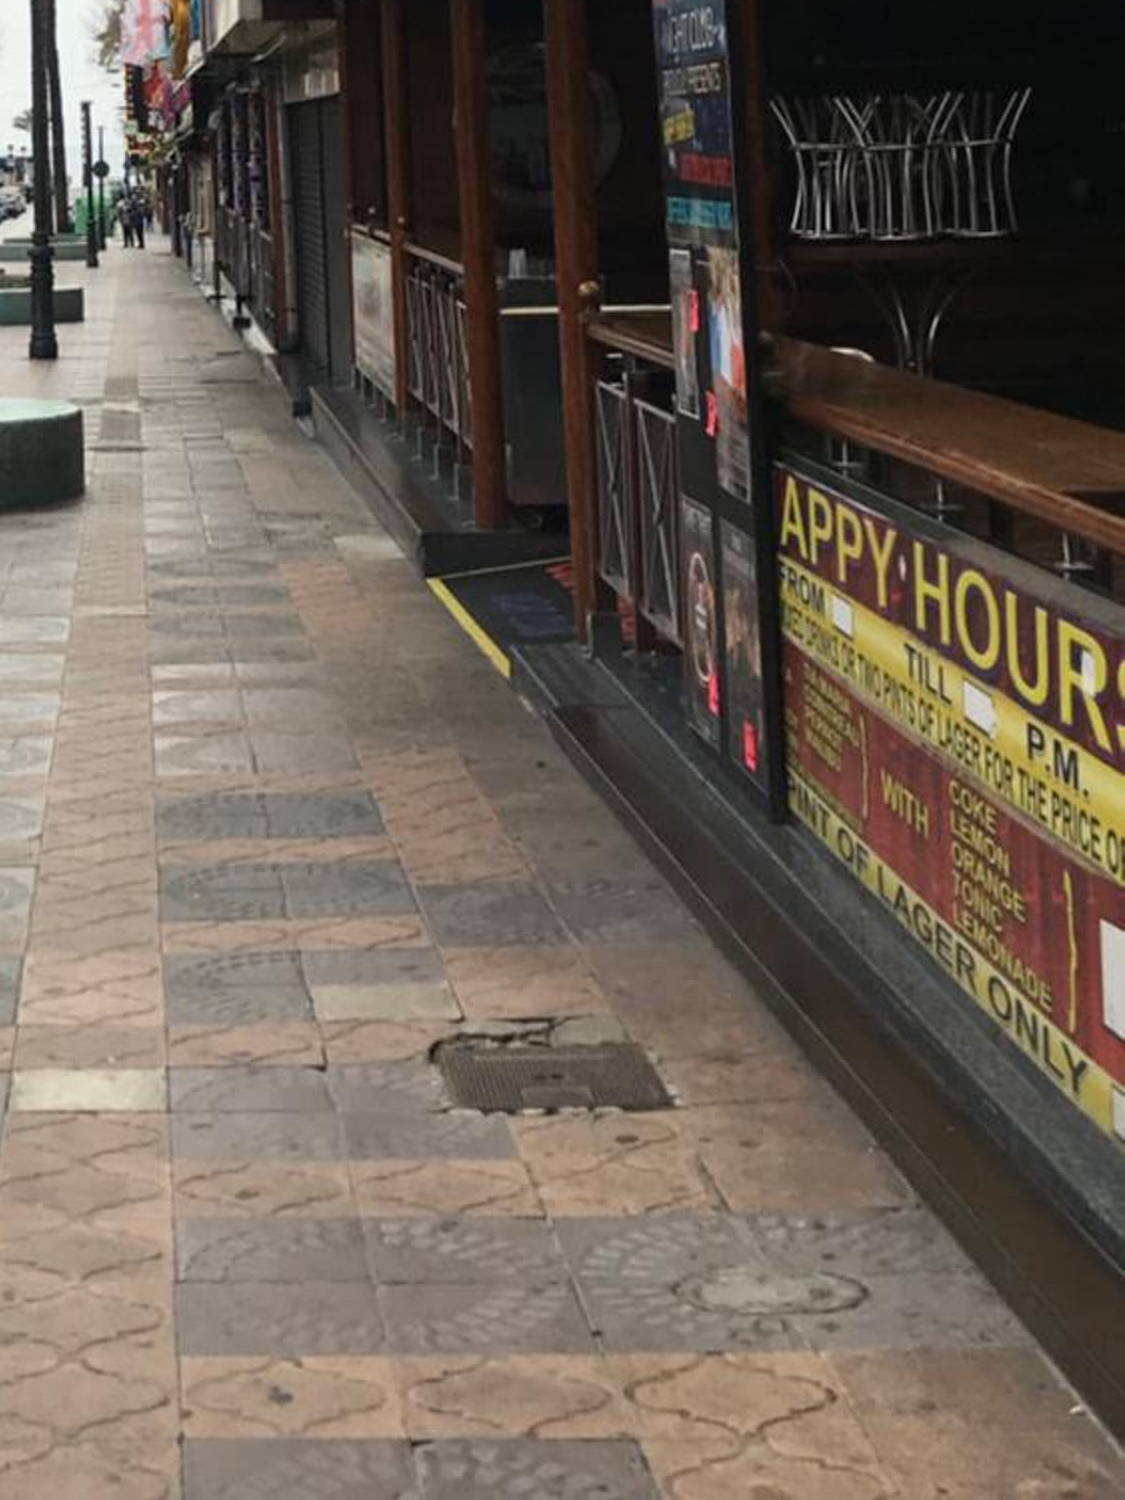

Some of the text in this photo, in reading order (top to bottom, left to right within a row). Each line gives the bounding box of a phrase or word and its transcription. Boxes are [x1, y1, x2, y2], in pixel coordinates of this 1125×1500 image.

[904, 643, 952, 704] TILL
[1027, 725, 1090, 799] P.M.
[881, 769, 930, 836] WITH
[883, 673, 915, 725] PINTS
[919, 695, 935, 740] OF
[938, 709, 981, 773] LAGER
[986, 747, 1013, 794] FOR
[1018, 767, 1047, 822] THE
[1052, 792, 1101, 861] PRICE
[950, 780, 997, 834] COKE
[951, 810, 1010, 877] LEMON
[951, 841, 1026, 922] ORANGE
[953, 873, 1003, 930] TONIC
[837, 820, 871, 882] OF
[876, 864, 980, 993] LAGER
[989, 977, 1087, 1094] ONLY
[953, 902, 1052, 1013] LEMONADE
